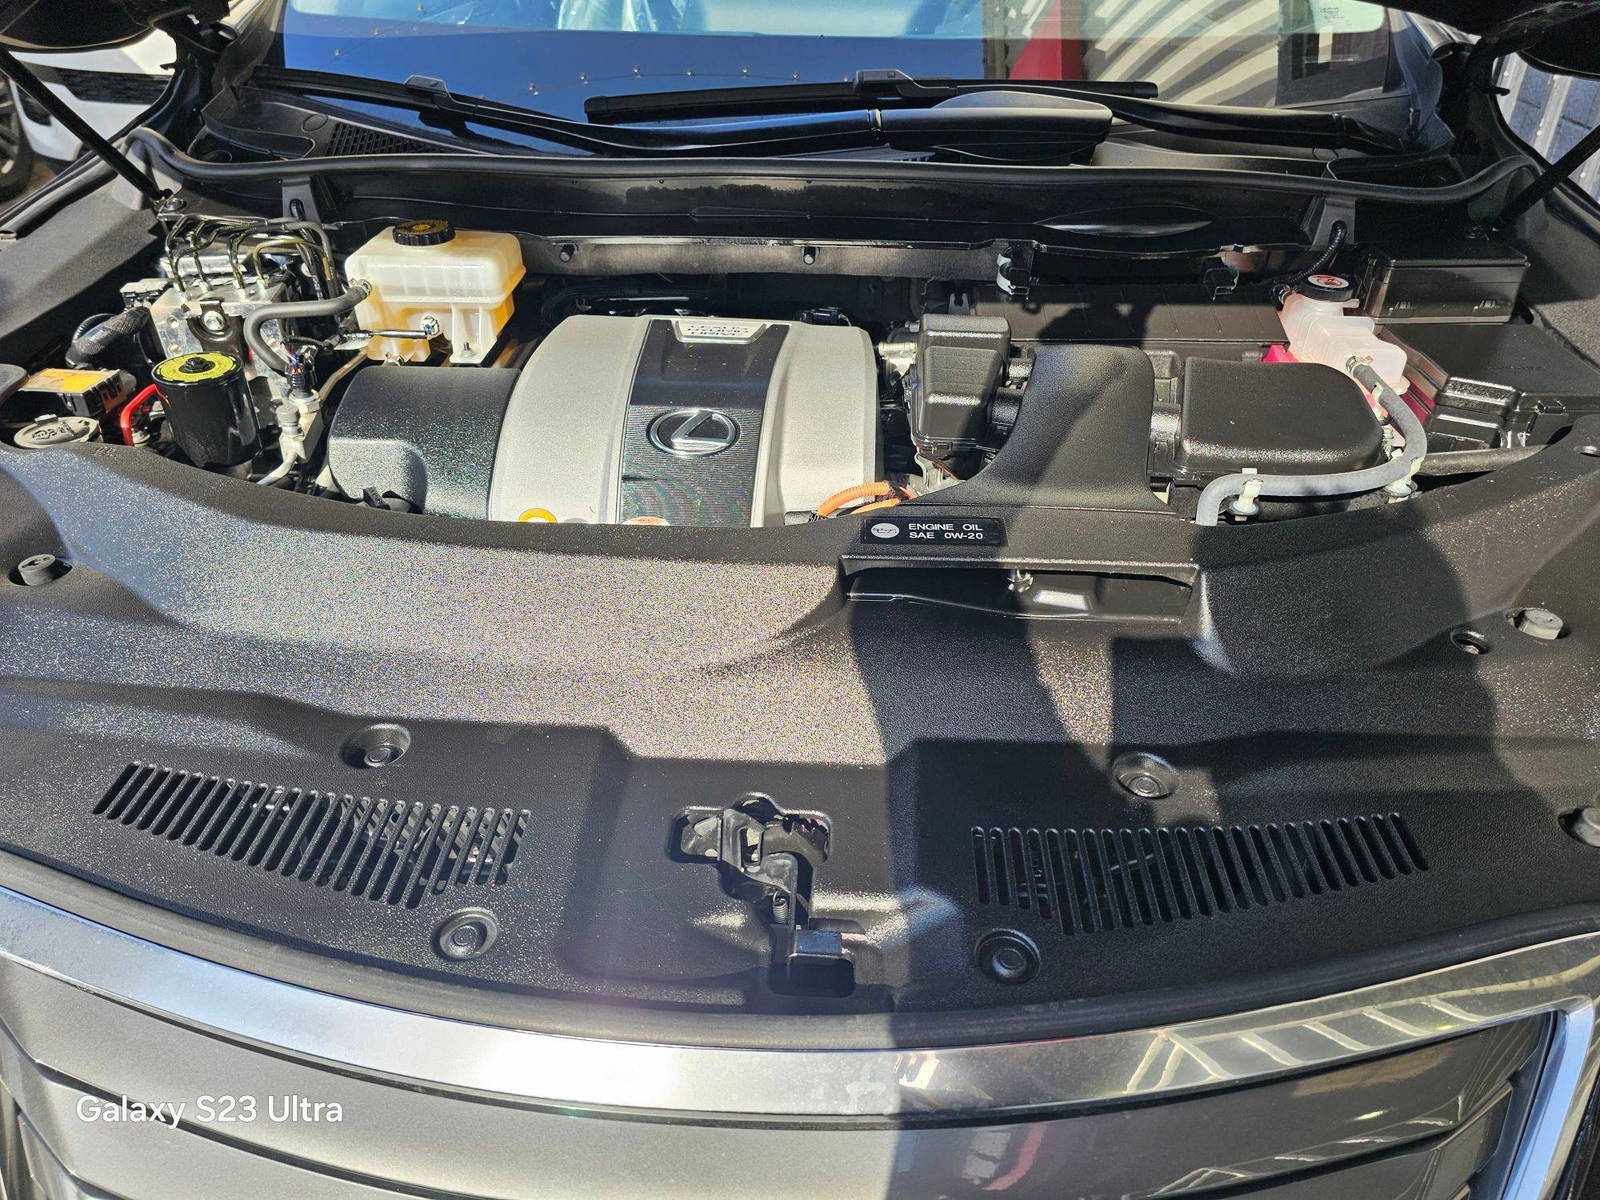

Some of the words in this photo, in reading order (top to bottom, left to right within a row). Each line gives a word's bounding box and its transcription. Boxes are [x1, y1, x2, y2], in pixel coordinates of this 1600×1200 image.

[908, 523, 954, 531] ENGINE
[962, 523, 983, 531] OIL
[944, 532, 984, 540] 0W-20
